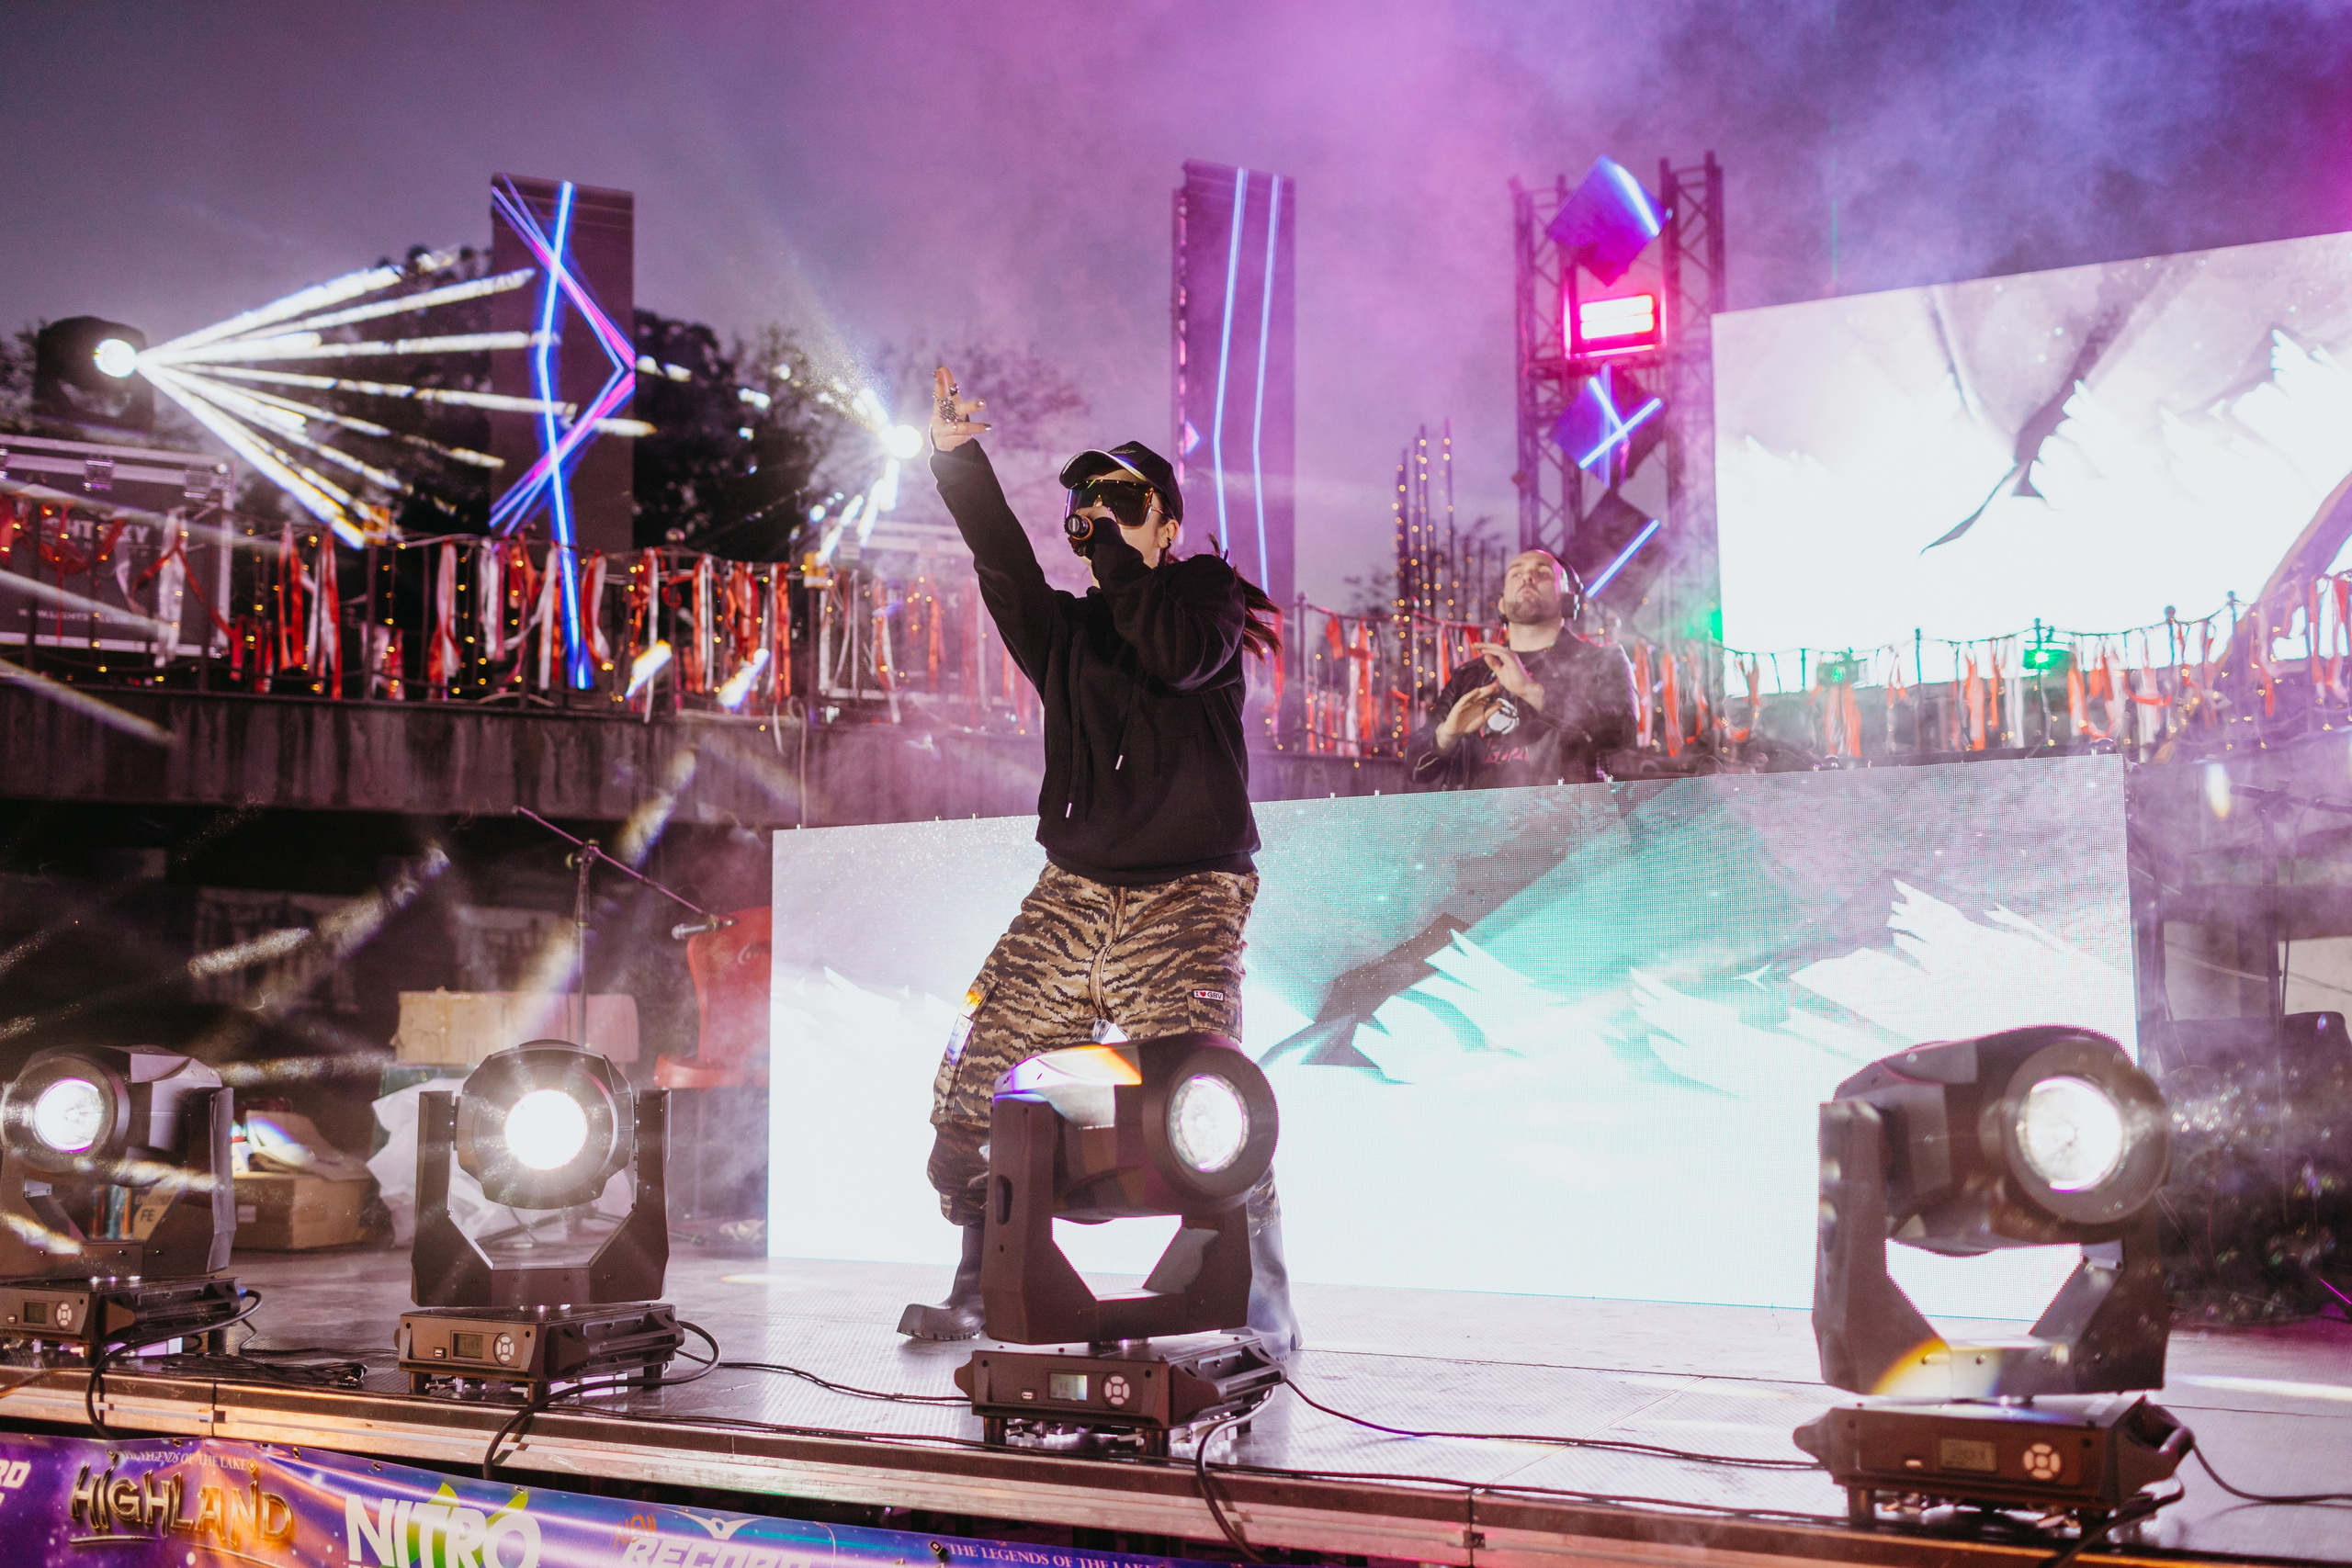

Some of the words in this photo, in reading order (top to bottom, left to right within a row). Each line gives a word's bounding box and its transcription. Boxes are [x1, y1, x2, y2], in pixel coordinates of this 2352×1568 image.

[139, 1451, 180, 1463] LEGENDS
[181, 1451, 194, 1464] OF
[198, 1453, 219, 1468] THE
[220, 1457, 247, 1471] LAKE
[71, 1462, 293, 1548] HIGHLAND
[345, 1494, 541, 1568] NITRO
[949, 1543, 978, 1557] THE
[980, 1547, 1049, 1565] LEGENDS
[1052, 1554, 1073, 1568] OF
